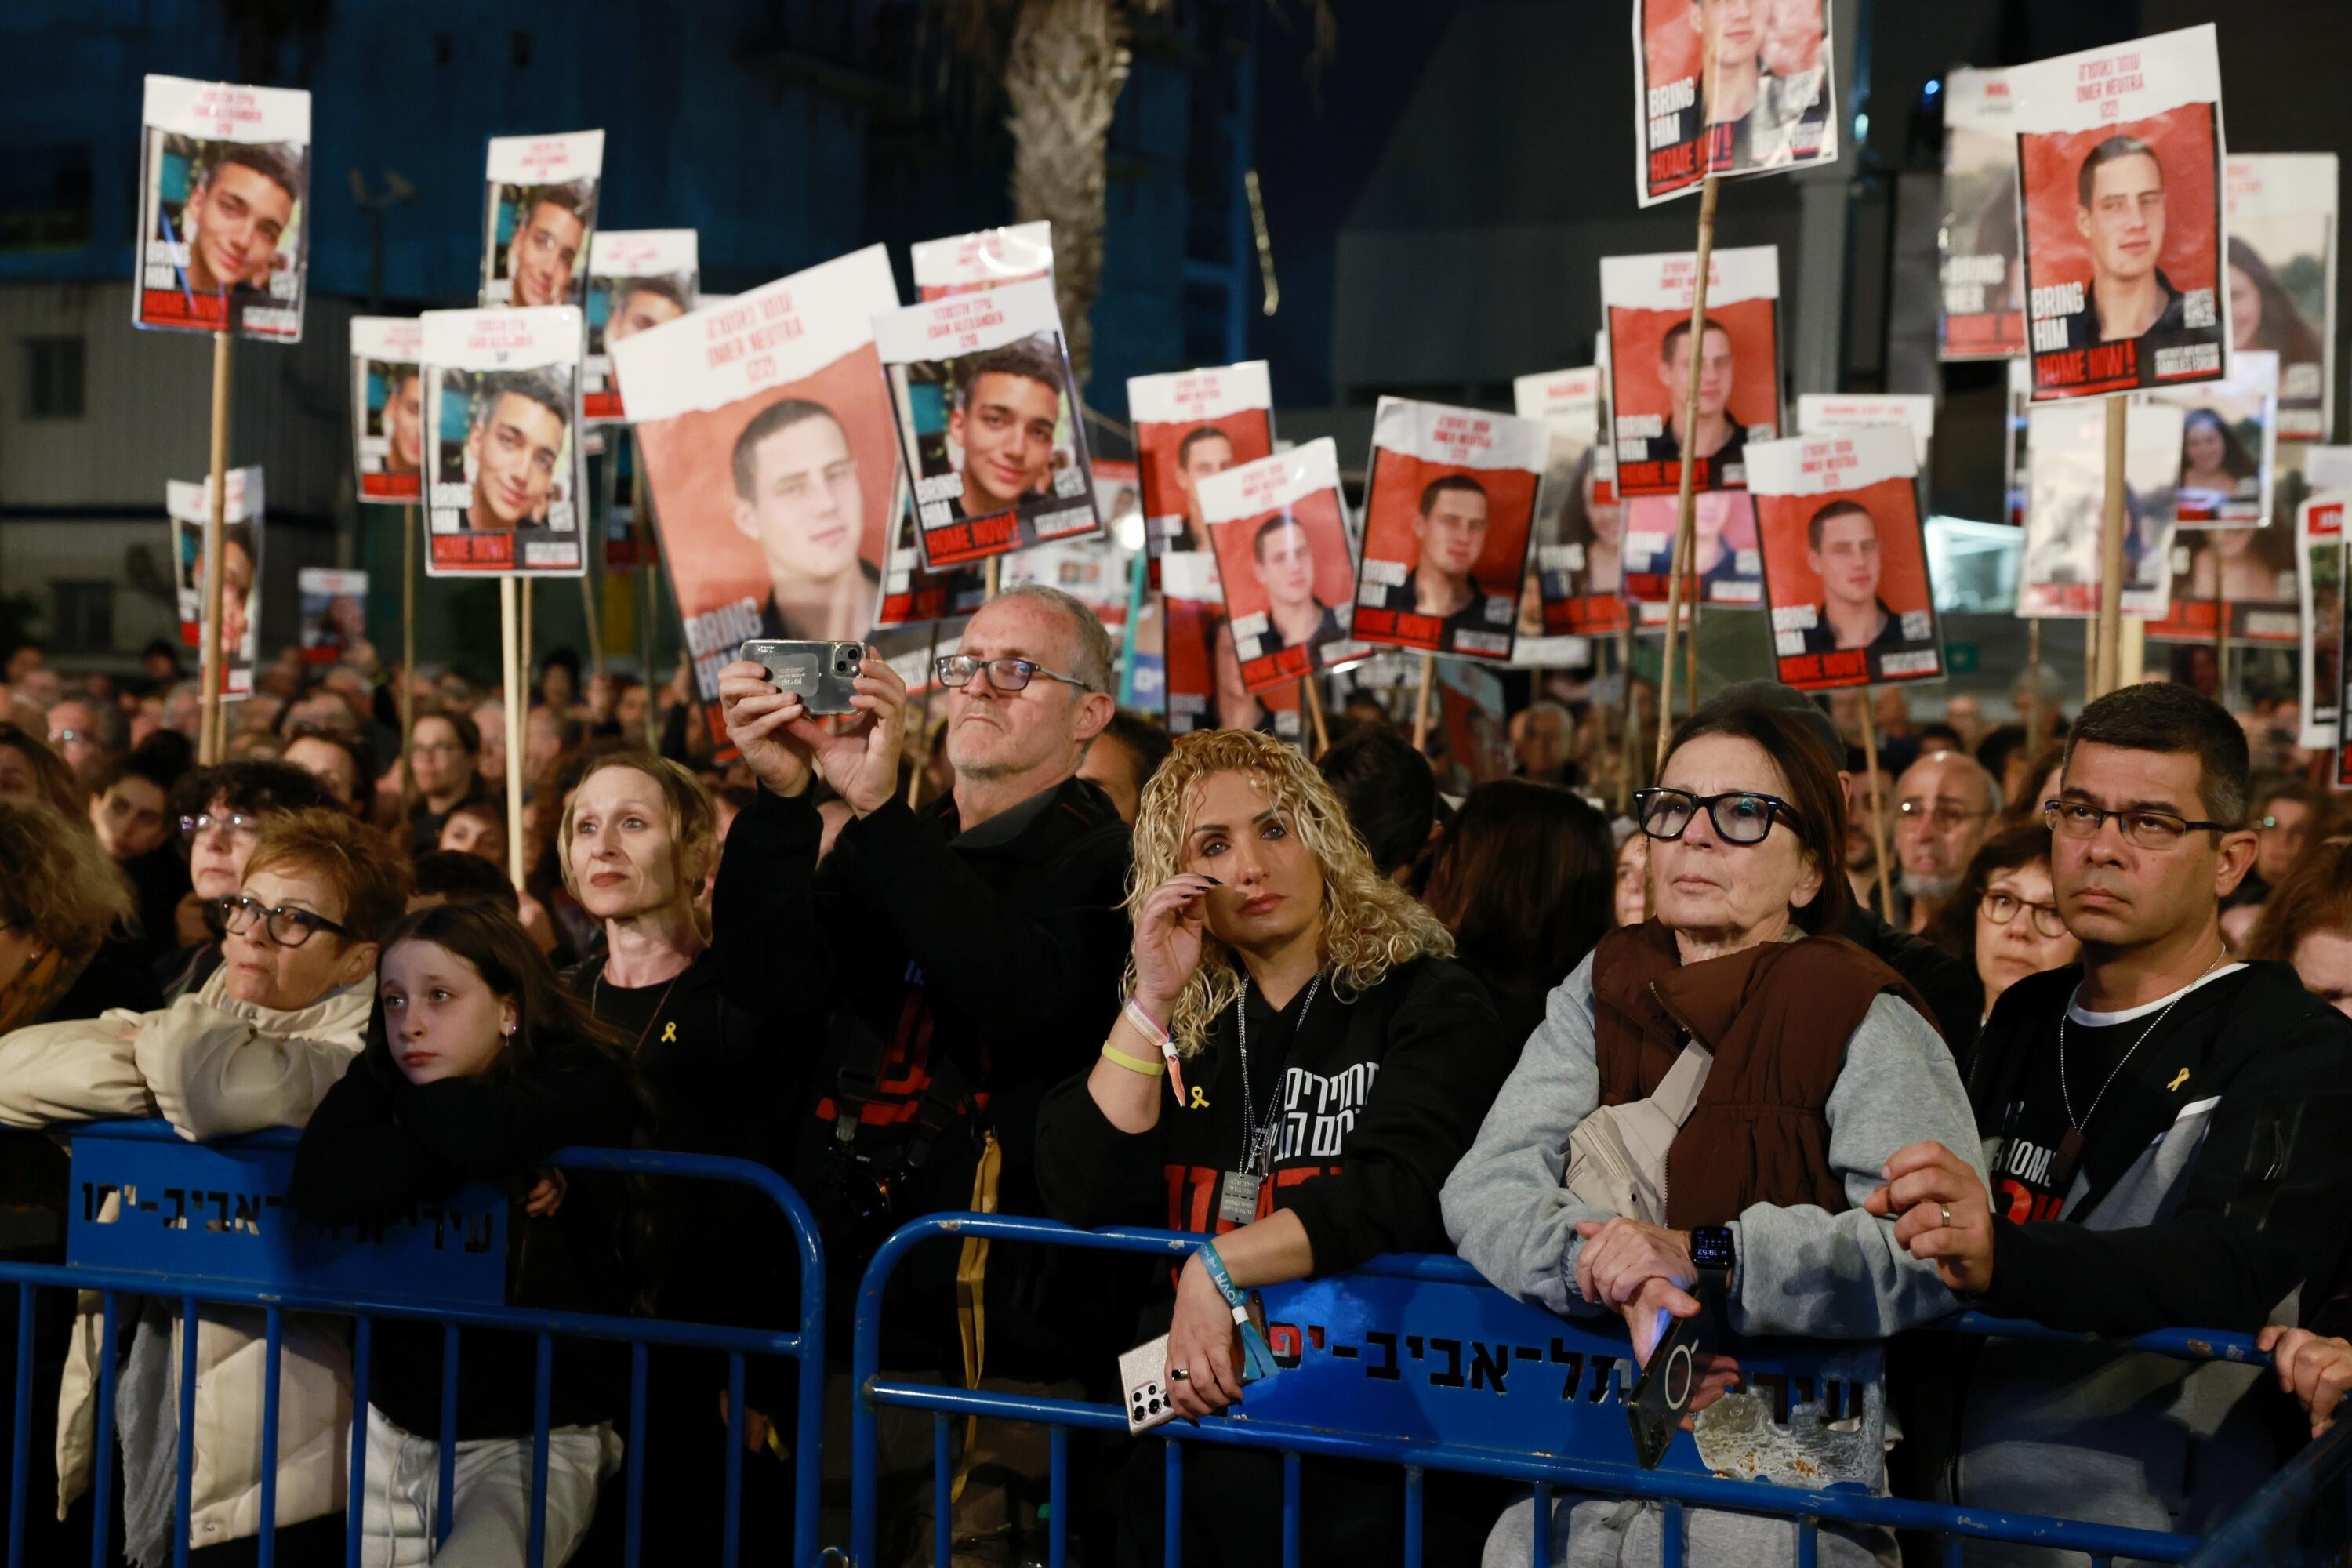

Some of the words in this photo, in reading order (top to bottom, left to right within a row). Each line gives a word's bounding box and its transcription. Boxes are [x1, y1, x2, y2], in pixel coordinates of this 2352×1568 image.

[1649, 76, 1695, 118] BRING
[1650, 112, 1681, 151] HIM
[1651, 142, 1695, 182] HOME
[2031, 281, 2085, 319] BRING
[2033, 316, 2069, 353] HIM
[2036, 350, 2086, 387] HOME
[2089, 339, 2136, 379] NOW!
[684, 597, 764, 657] BRING
[1310, 1108, 1361, 1156] תם
[82, 1181, 314, 1237] -אביב-יפו
[1269, 1319, 1632, 1407] תל-אביב-יפ
[1728, 1370, 1864, 1432] עירי
